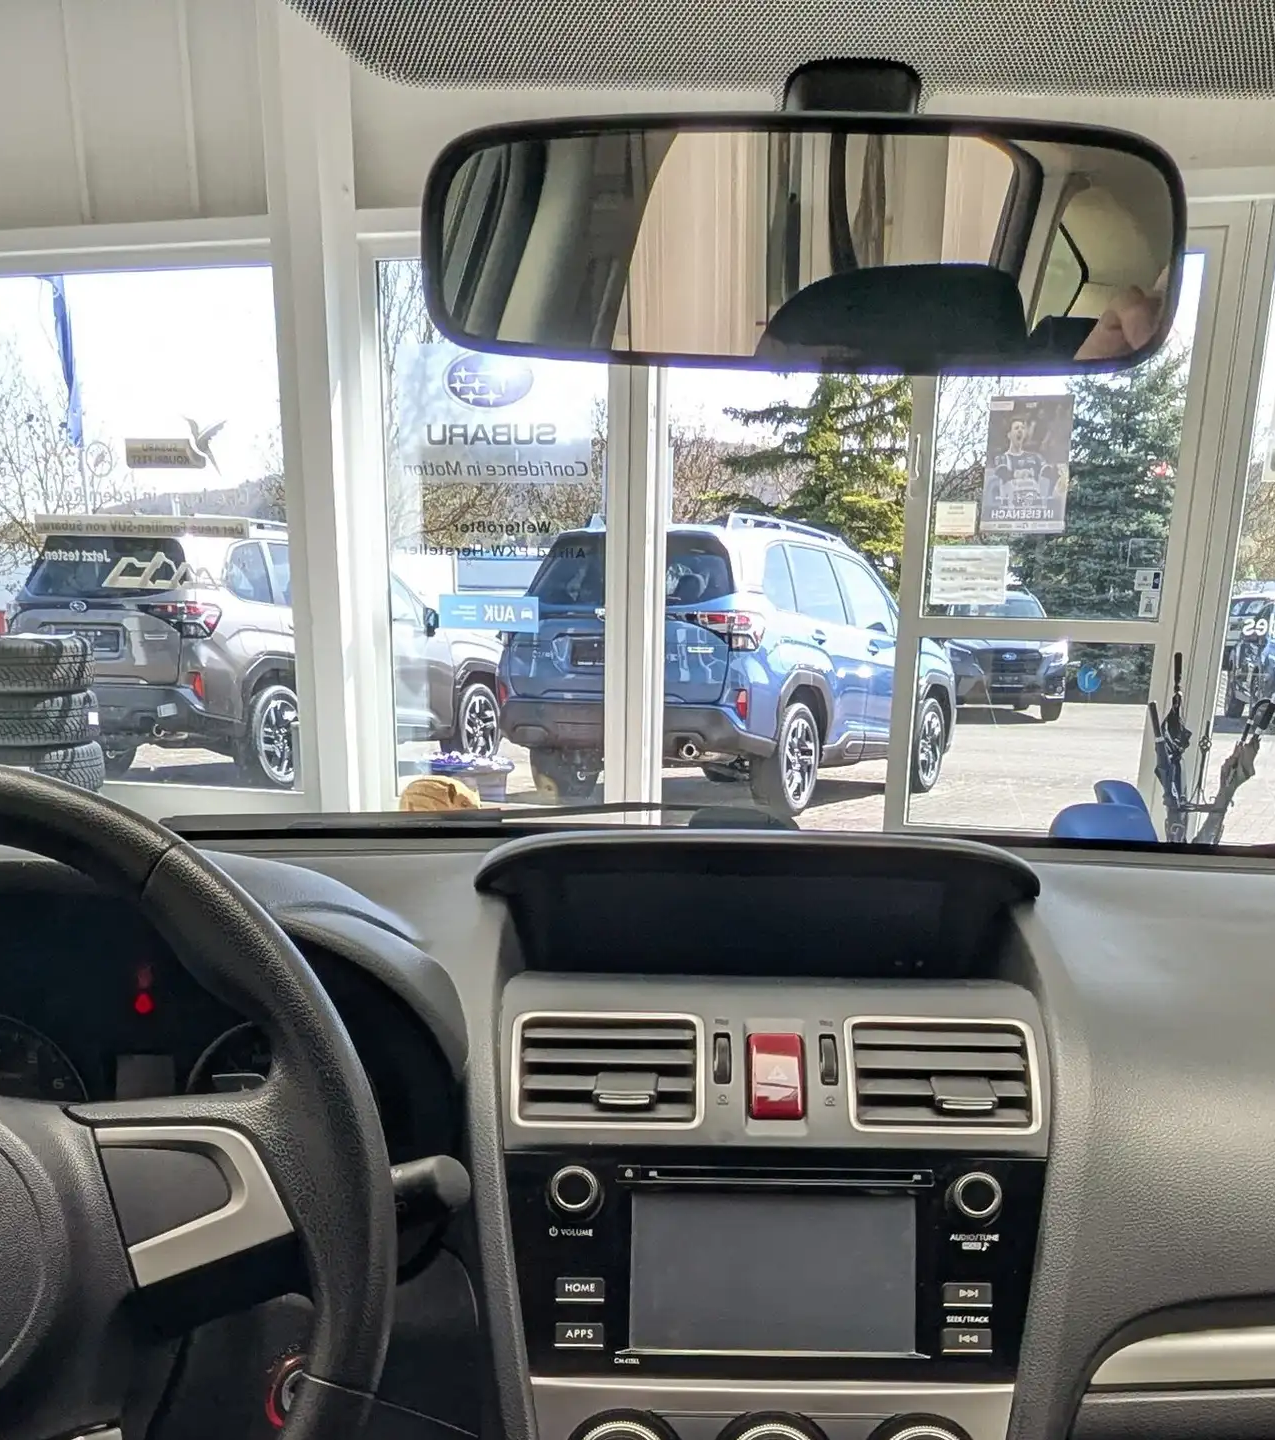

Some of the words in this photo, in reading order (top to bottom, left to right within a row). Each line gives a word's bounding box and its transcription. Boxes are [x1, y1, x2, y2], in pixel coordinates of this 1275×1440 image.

[560, 1228, 594, 1237] VOLUME
[565, 1283, 596, 1293] HOME
[946, 1315, 989, 1323] SEEK/TRACK
[565, 1328, 594, 1339] APPS
